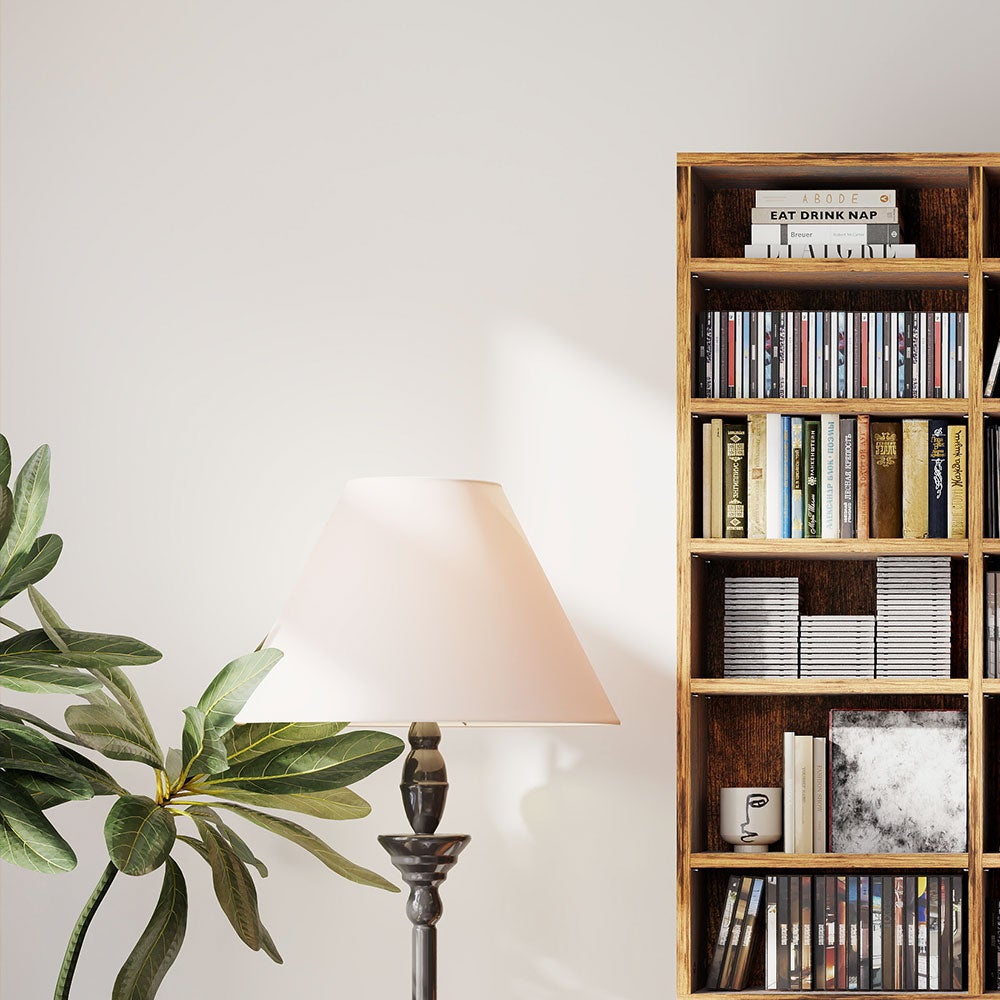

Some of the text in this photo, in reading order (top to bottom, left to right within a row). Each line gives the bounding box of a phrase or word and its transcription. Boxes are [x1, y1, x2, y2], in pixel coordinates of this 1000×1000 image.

[802, 193, 859, 204] ABODE
[770, 211, 878, 221] EAT DRINK NAP
[827, 421, 835, 454] ПОЭМЫ
[844, 433, 852, 500] ЛЕСНАЯ КРЕПОСТЬ
[951, 458, 963, 488] Жажда
